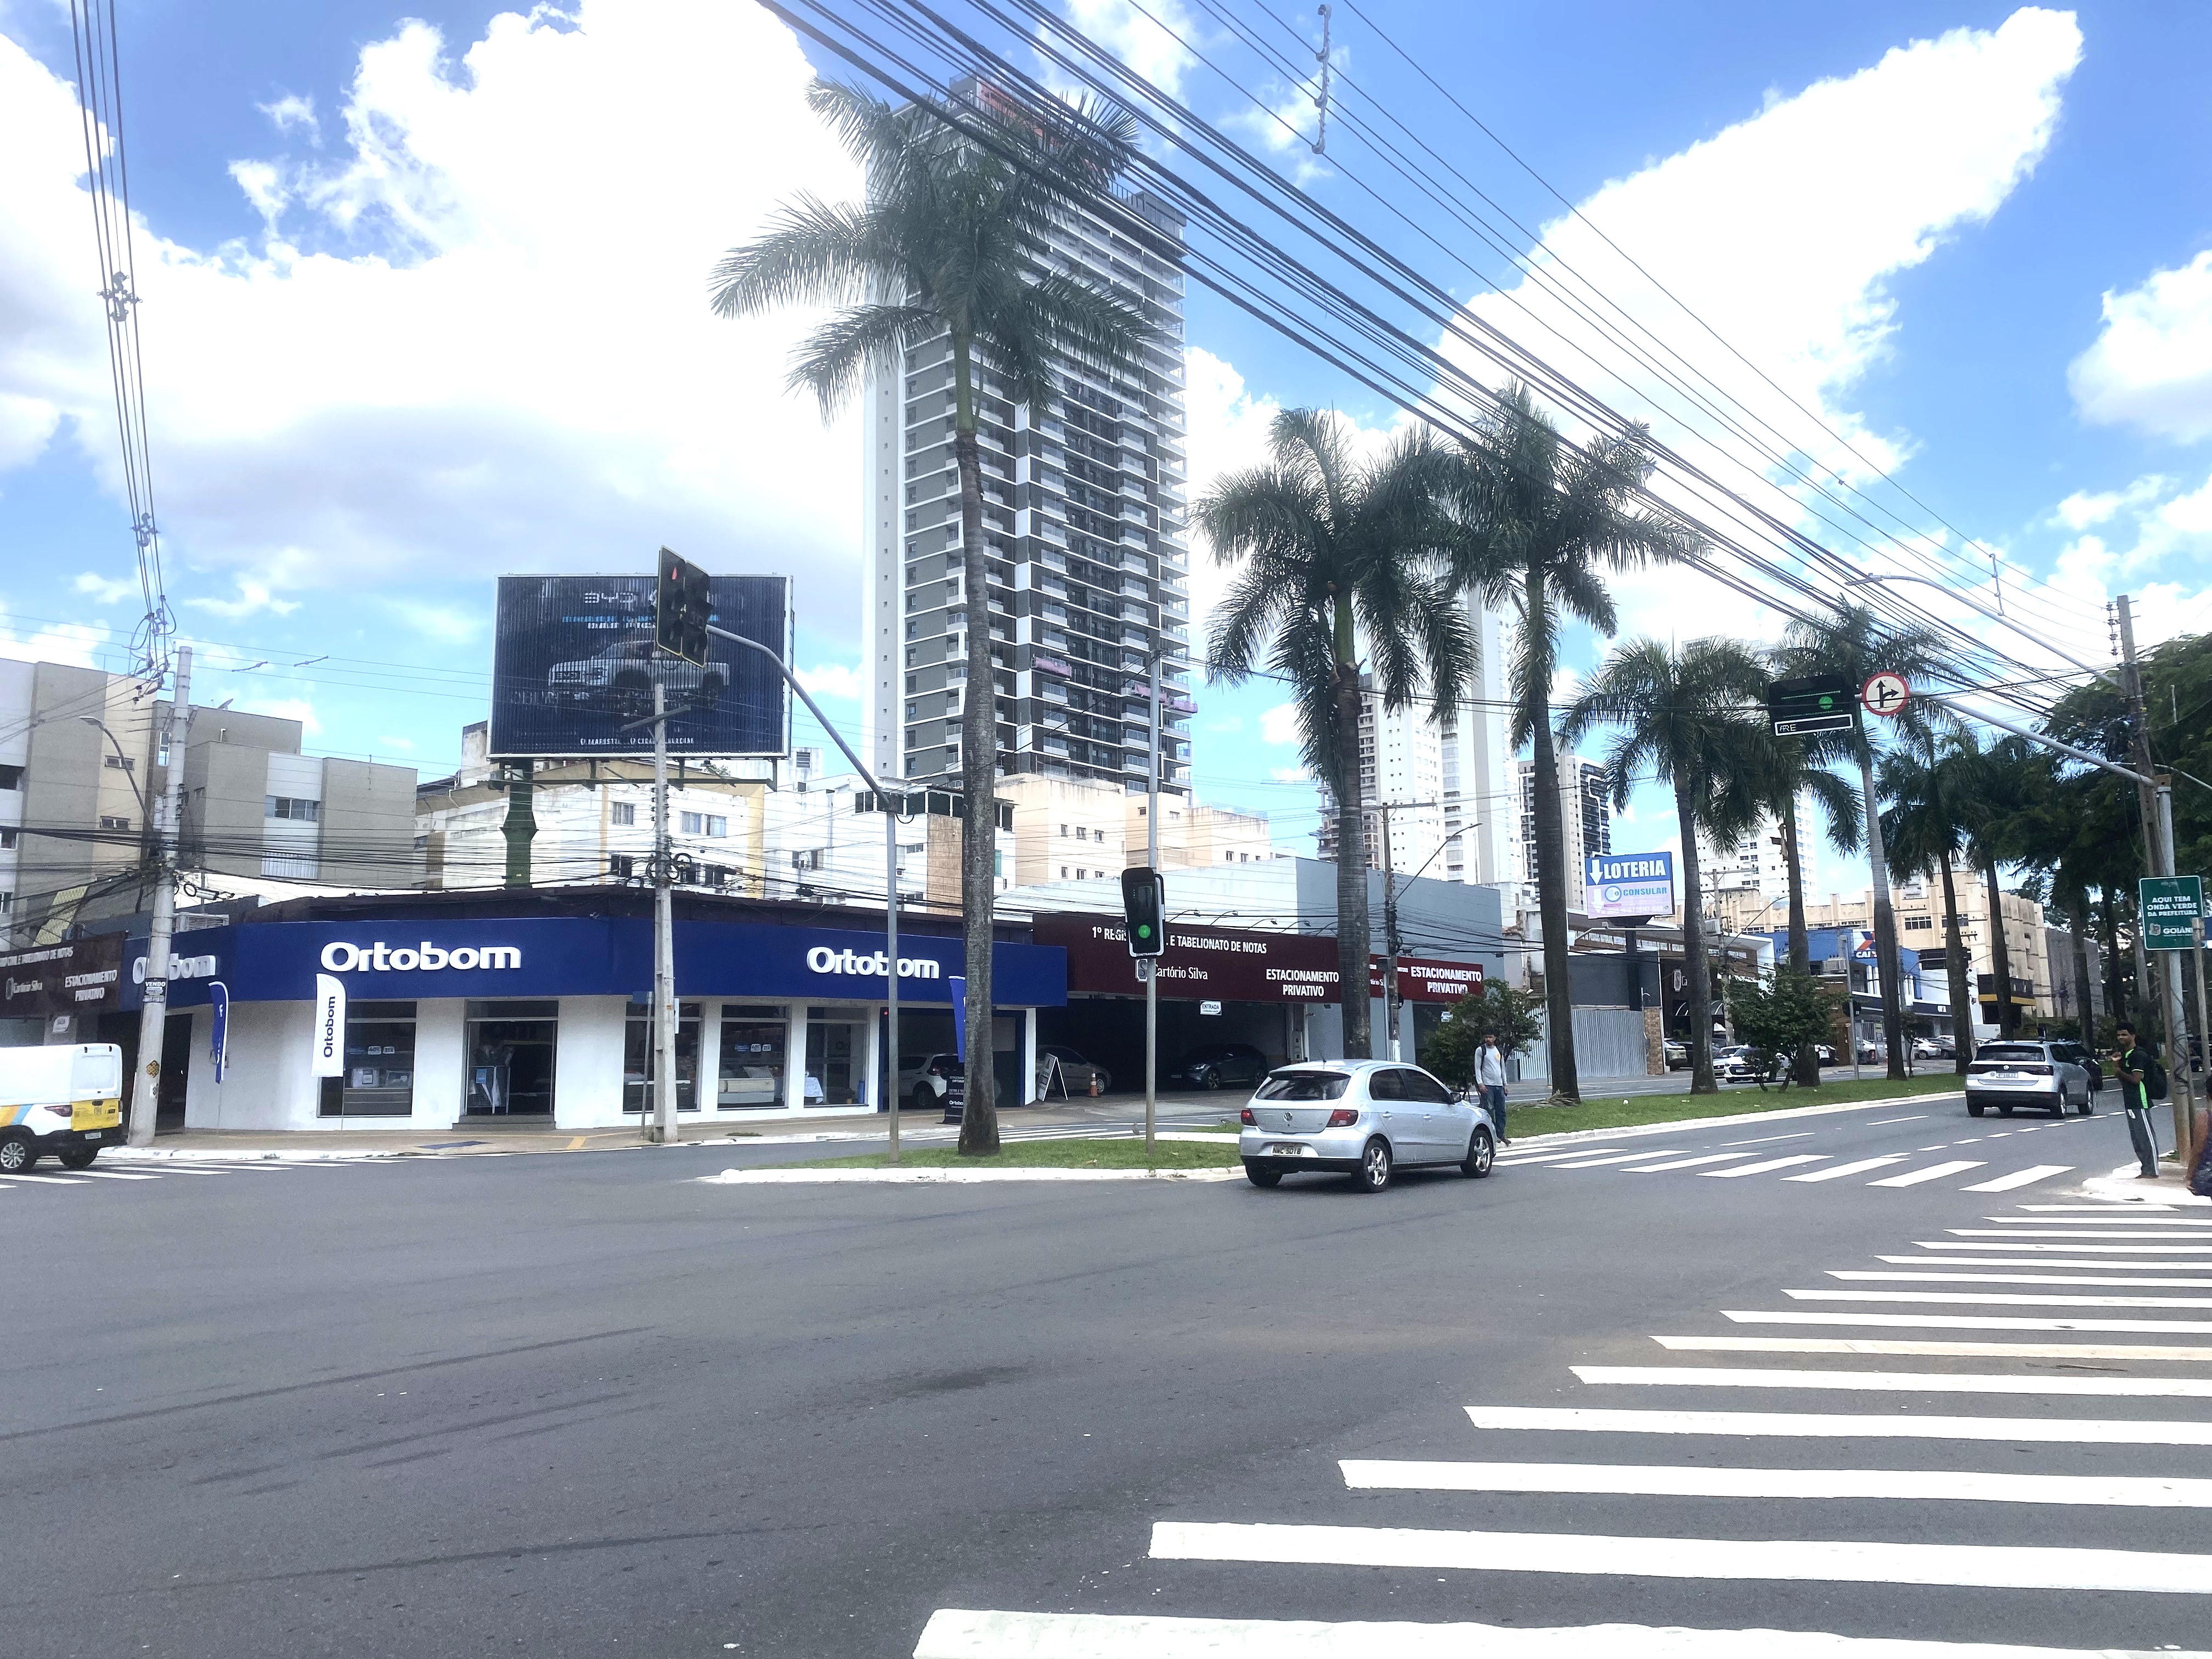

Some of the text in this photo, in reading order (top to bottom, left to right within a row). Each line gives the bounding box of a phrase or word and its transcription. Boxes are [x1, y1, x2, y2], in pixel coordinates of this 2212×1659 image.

[1604, 860, 1666, 879] LOTERIA
[1623, 887, 1667, 896] CONSULAR
[1170, 935, 1175, 946] E
[1177, 935, 1229, 951] TABELIONATO
[1231, 940, 1241, 952] DE
[1243, 941, 1267, 955] NOTAS
[320, 941, 522, 972] Ortobom
[806, 946, 939, 979] Ortobom
[1188, 967, 1208, 980] Silva
[1266, 969, 1339, 983] ESTACIONAMENTO
[1410, 966, 1482, 982] ESTACIONAMENTO
[1283, 984, 1324, 997] PRIVATIVO
[1427, 981, 1468, 994] PRIVATIVO
[323, 995, 336, 1058] Ortobom
